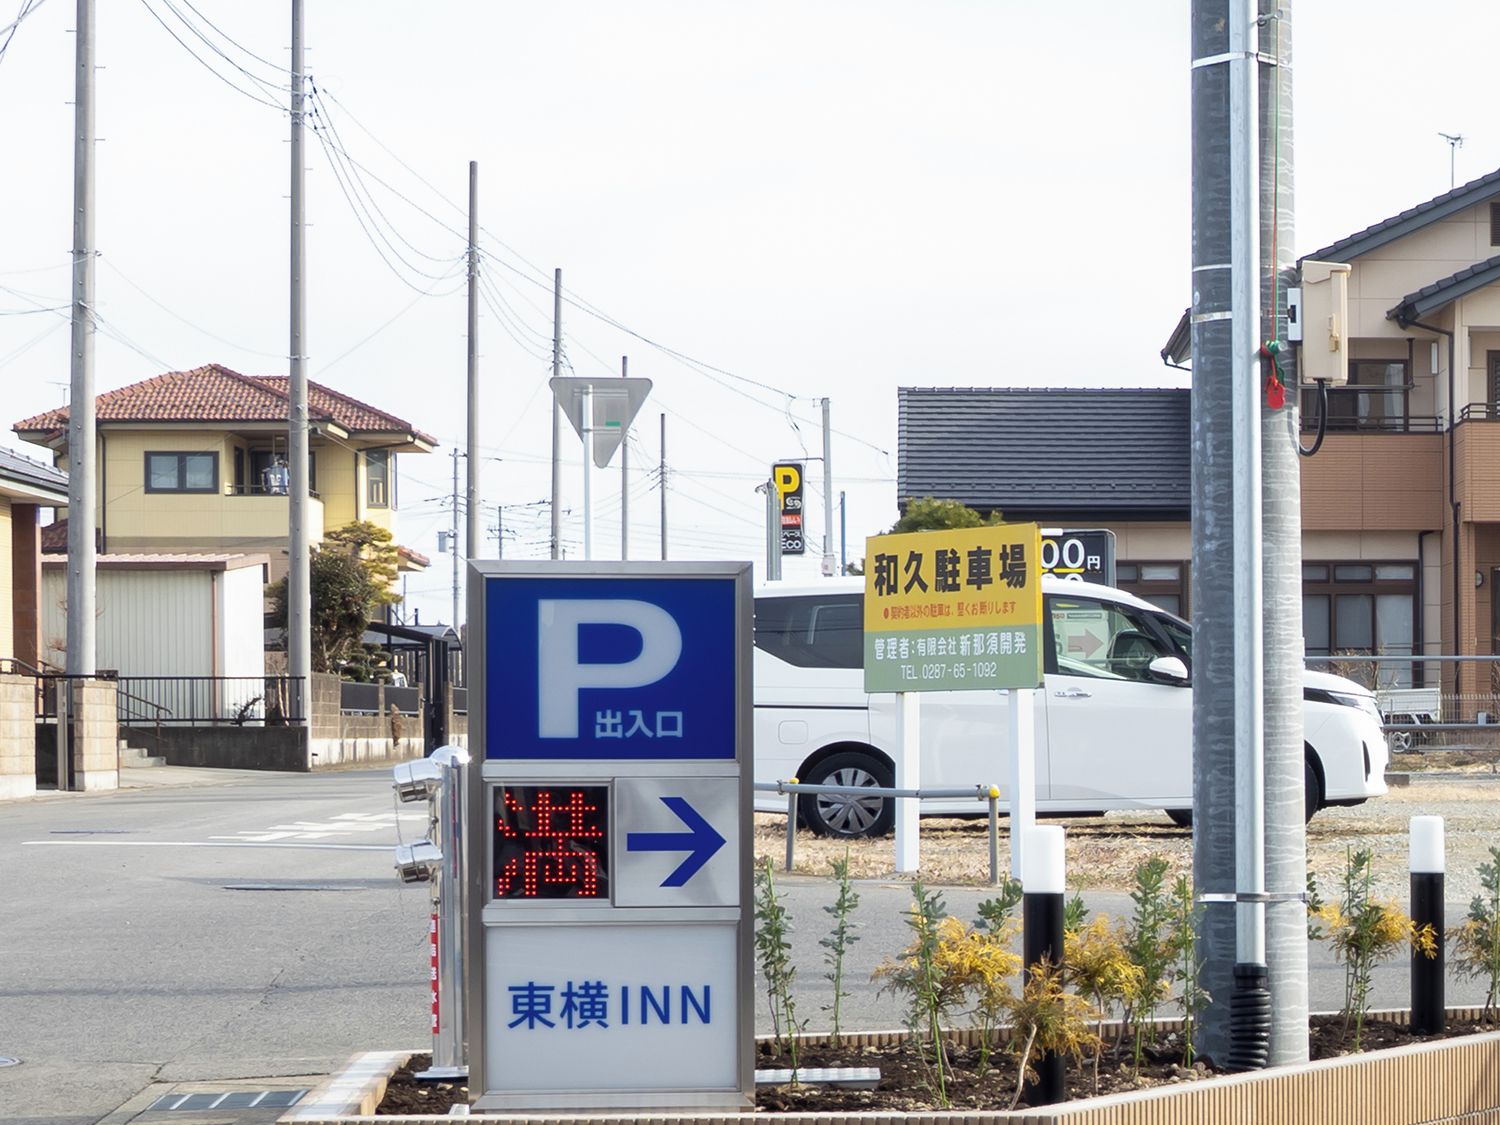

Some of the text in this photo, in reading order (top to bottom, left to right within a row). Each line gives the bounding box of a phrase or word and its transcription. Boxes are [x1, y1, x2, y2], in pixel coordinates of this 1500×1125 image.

[775, 466, 800, 511] P
[874, 543, 1028, 597] 和久駐車場
[537, 598, 683, 739] P
[901, 662, 997, 680] TEL 0287-65-1092
[595, 710, 684, 739] 出入口
[497, 791, 603, 896] 満
[506, 981, 712, 1030] 東横INN
